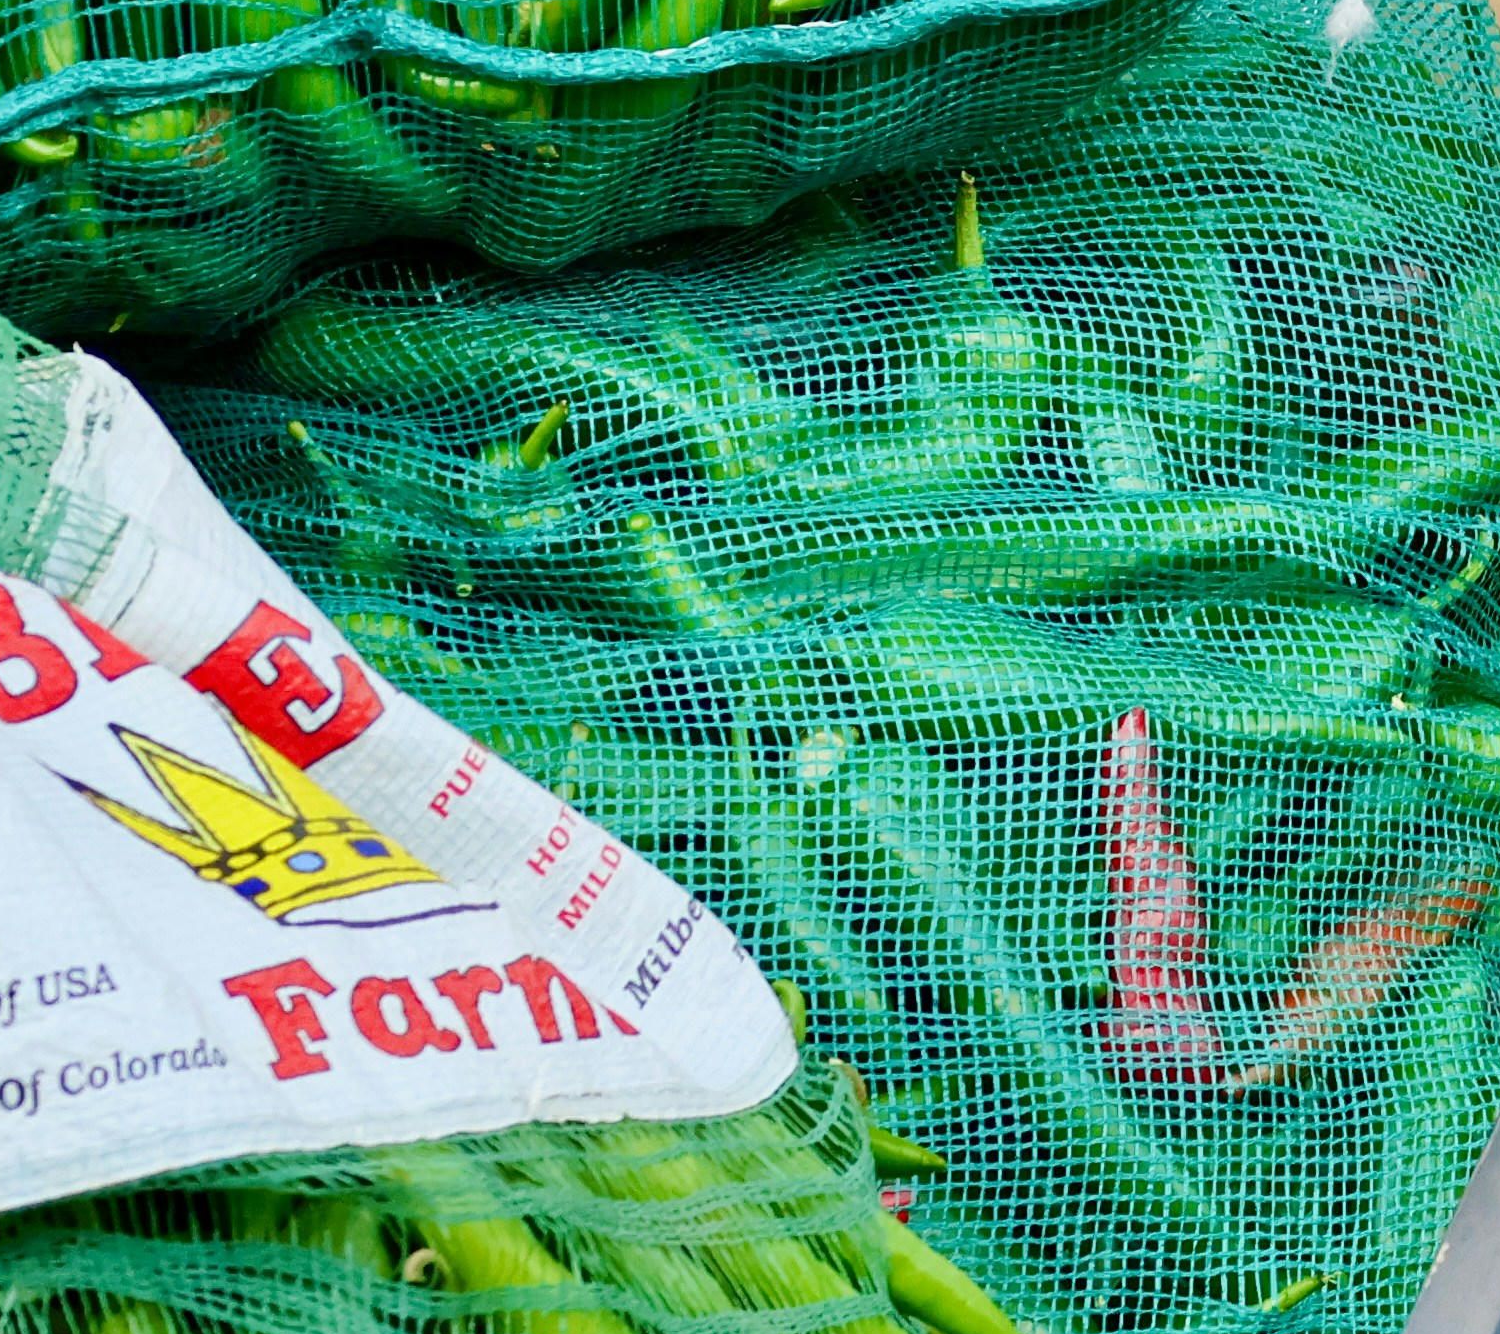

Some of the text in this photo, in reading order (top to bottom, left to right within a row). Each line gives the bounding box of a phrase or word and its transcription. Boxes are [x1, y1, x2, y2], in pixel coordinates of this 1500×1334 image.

[526, 803, 579, 877] HOT
[556, 843, 623, 931] MILD
[35, 963, 119, 1006] USA
